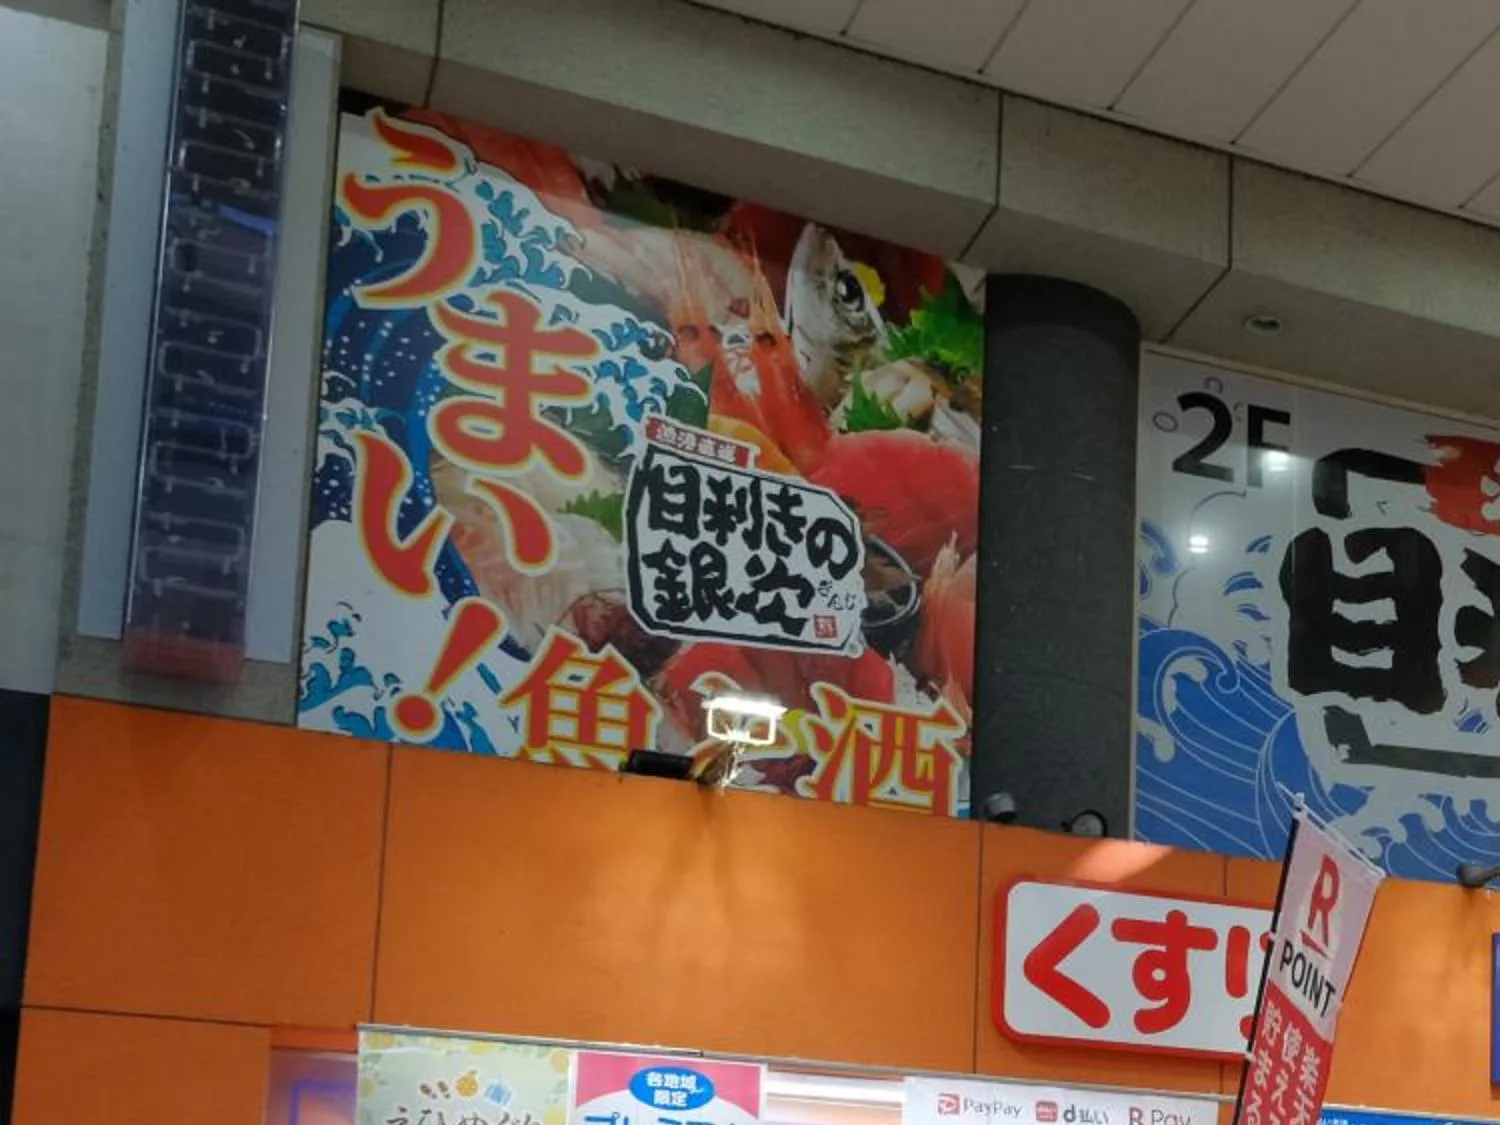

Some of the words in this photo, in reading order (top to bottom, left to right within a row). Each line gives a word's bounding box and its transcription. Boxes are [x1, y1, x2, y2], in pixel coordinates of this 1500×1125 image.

[1170, 390, 1291, 489] 2F
[1281, 937, 1337, 1019] POINT
[963, 1098, 1023, 1119] PayPay
